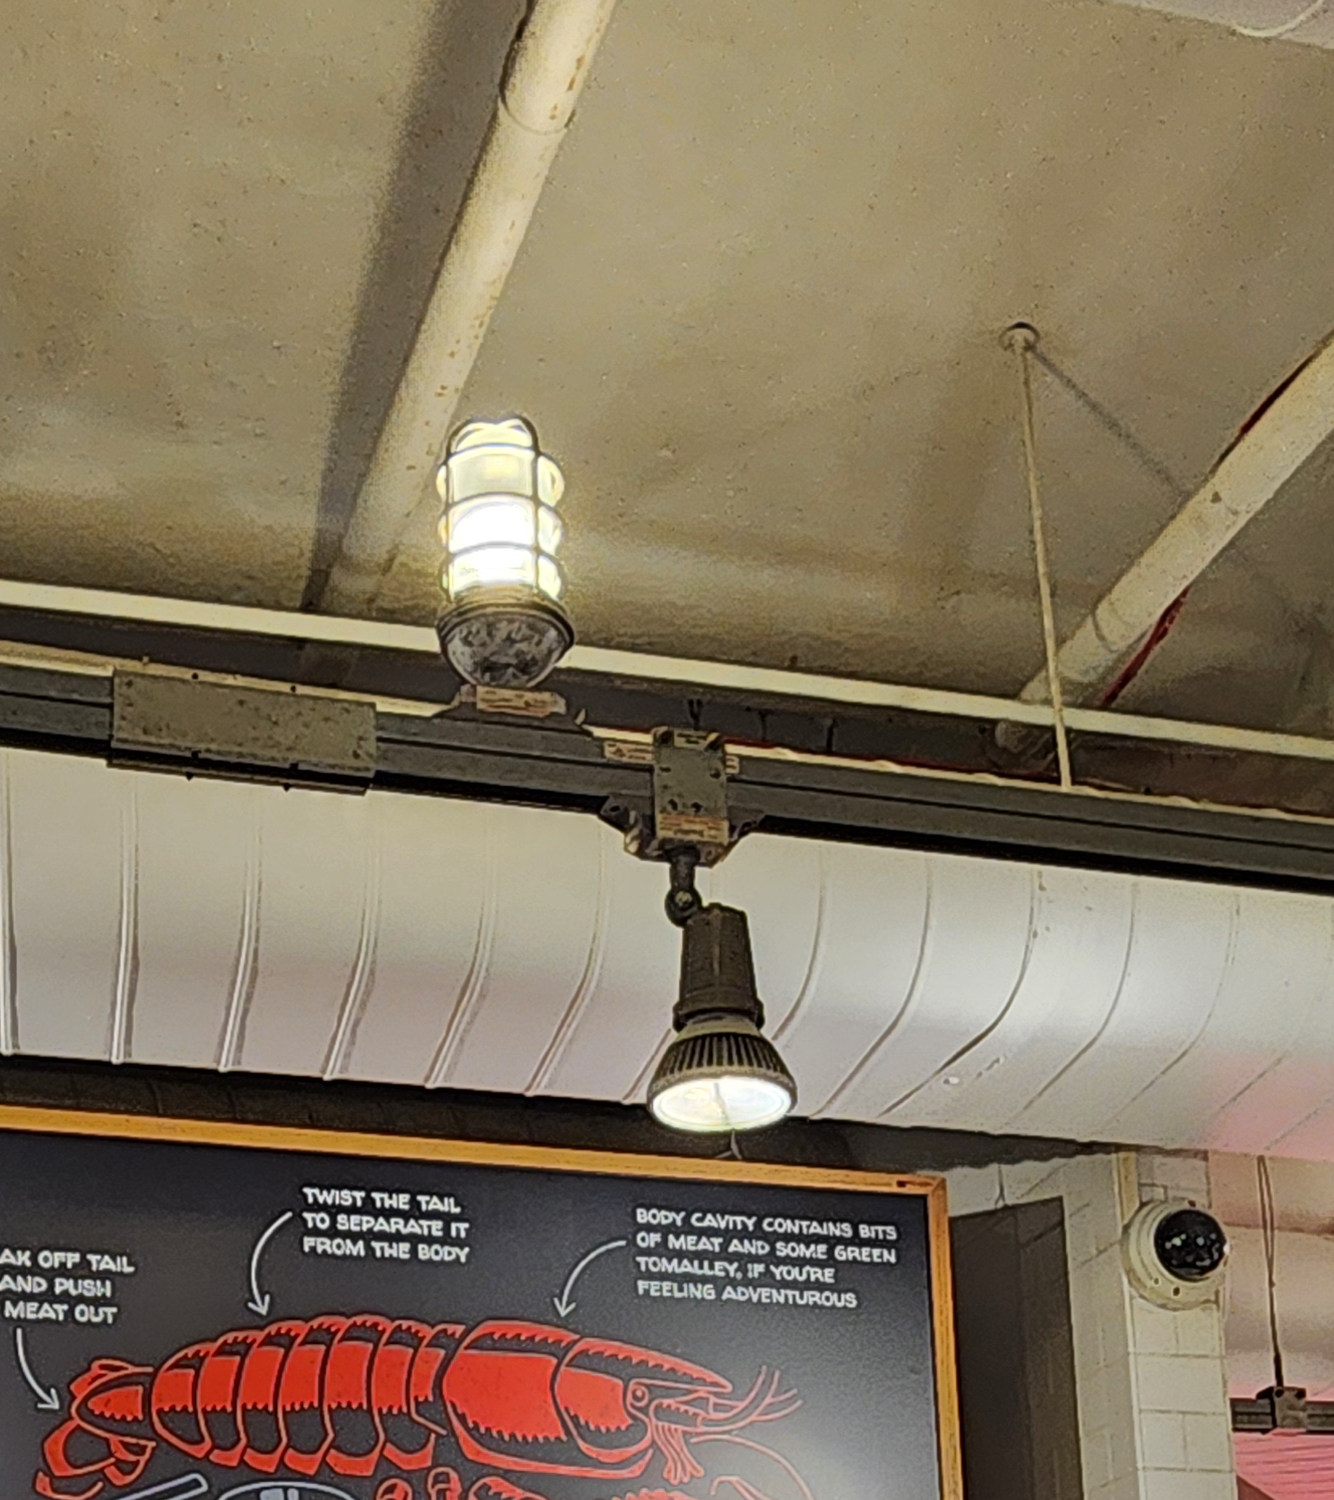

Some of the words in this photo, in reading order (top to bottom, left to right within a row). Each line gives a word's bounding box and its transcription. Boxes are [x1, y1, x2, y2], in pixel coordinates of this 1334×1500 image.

[302, 1187, 366, 1208] TWIST
[371, 1191, 411, 1211] THE
[416, 1194, 462, 1213] TAIL
[302, 1211, 330, 1231] TO
[335, 1213, 443, 1237] SEPARATE
[450, 1220, 469, 1239] IT
[636, 1207, 686, 1226] BODY
[690, 1211, 757, 1232] CAVITY
[762, 1217, 853, 1238] CONTAINS
[858, 1224, 898, 1240] BITS
[302, 1236, 366, 1258] FROM
[370, 1240, 412, 1259] THE
[418, 1242, 470, 1263] BODY
[636, 1231, 661, 1248] OF
[668, 1234, 723, 1252] MEAT
[728, 1238, 770, 1256] AND
[775, 1241, 828, 1258] SOME
[834, 1245, 896, 1263] GREEN
[38, 1249, 80, 1271] OFF
[86, 1253, 136, 1274] TAIL
[747, 1264, 765, 1278] IF
[54, 1277, 112, 1298] PUSH
[637, 1280, 716, 1300] FEELING
[721, 1285, 858, 1308] ADVENTUROUS
[4, 1300, 68, 1323] MEAT
[74, 1304, 119, 1324] OUT
